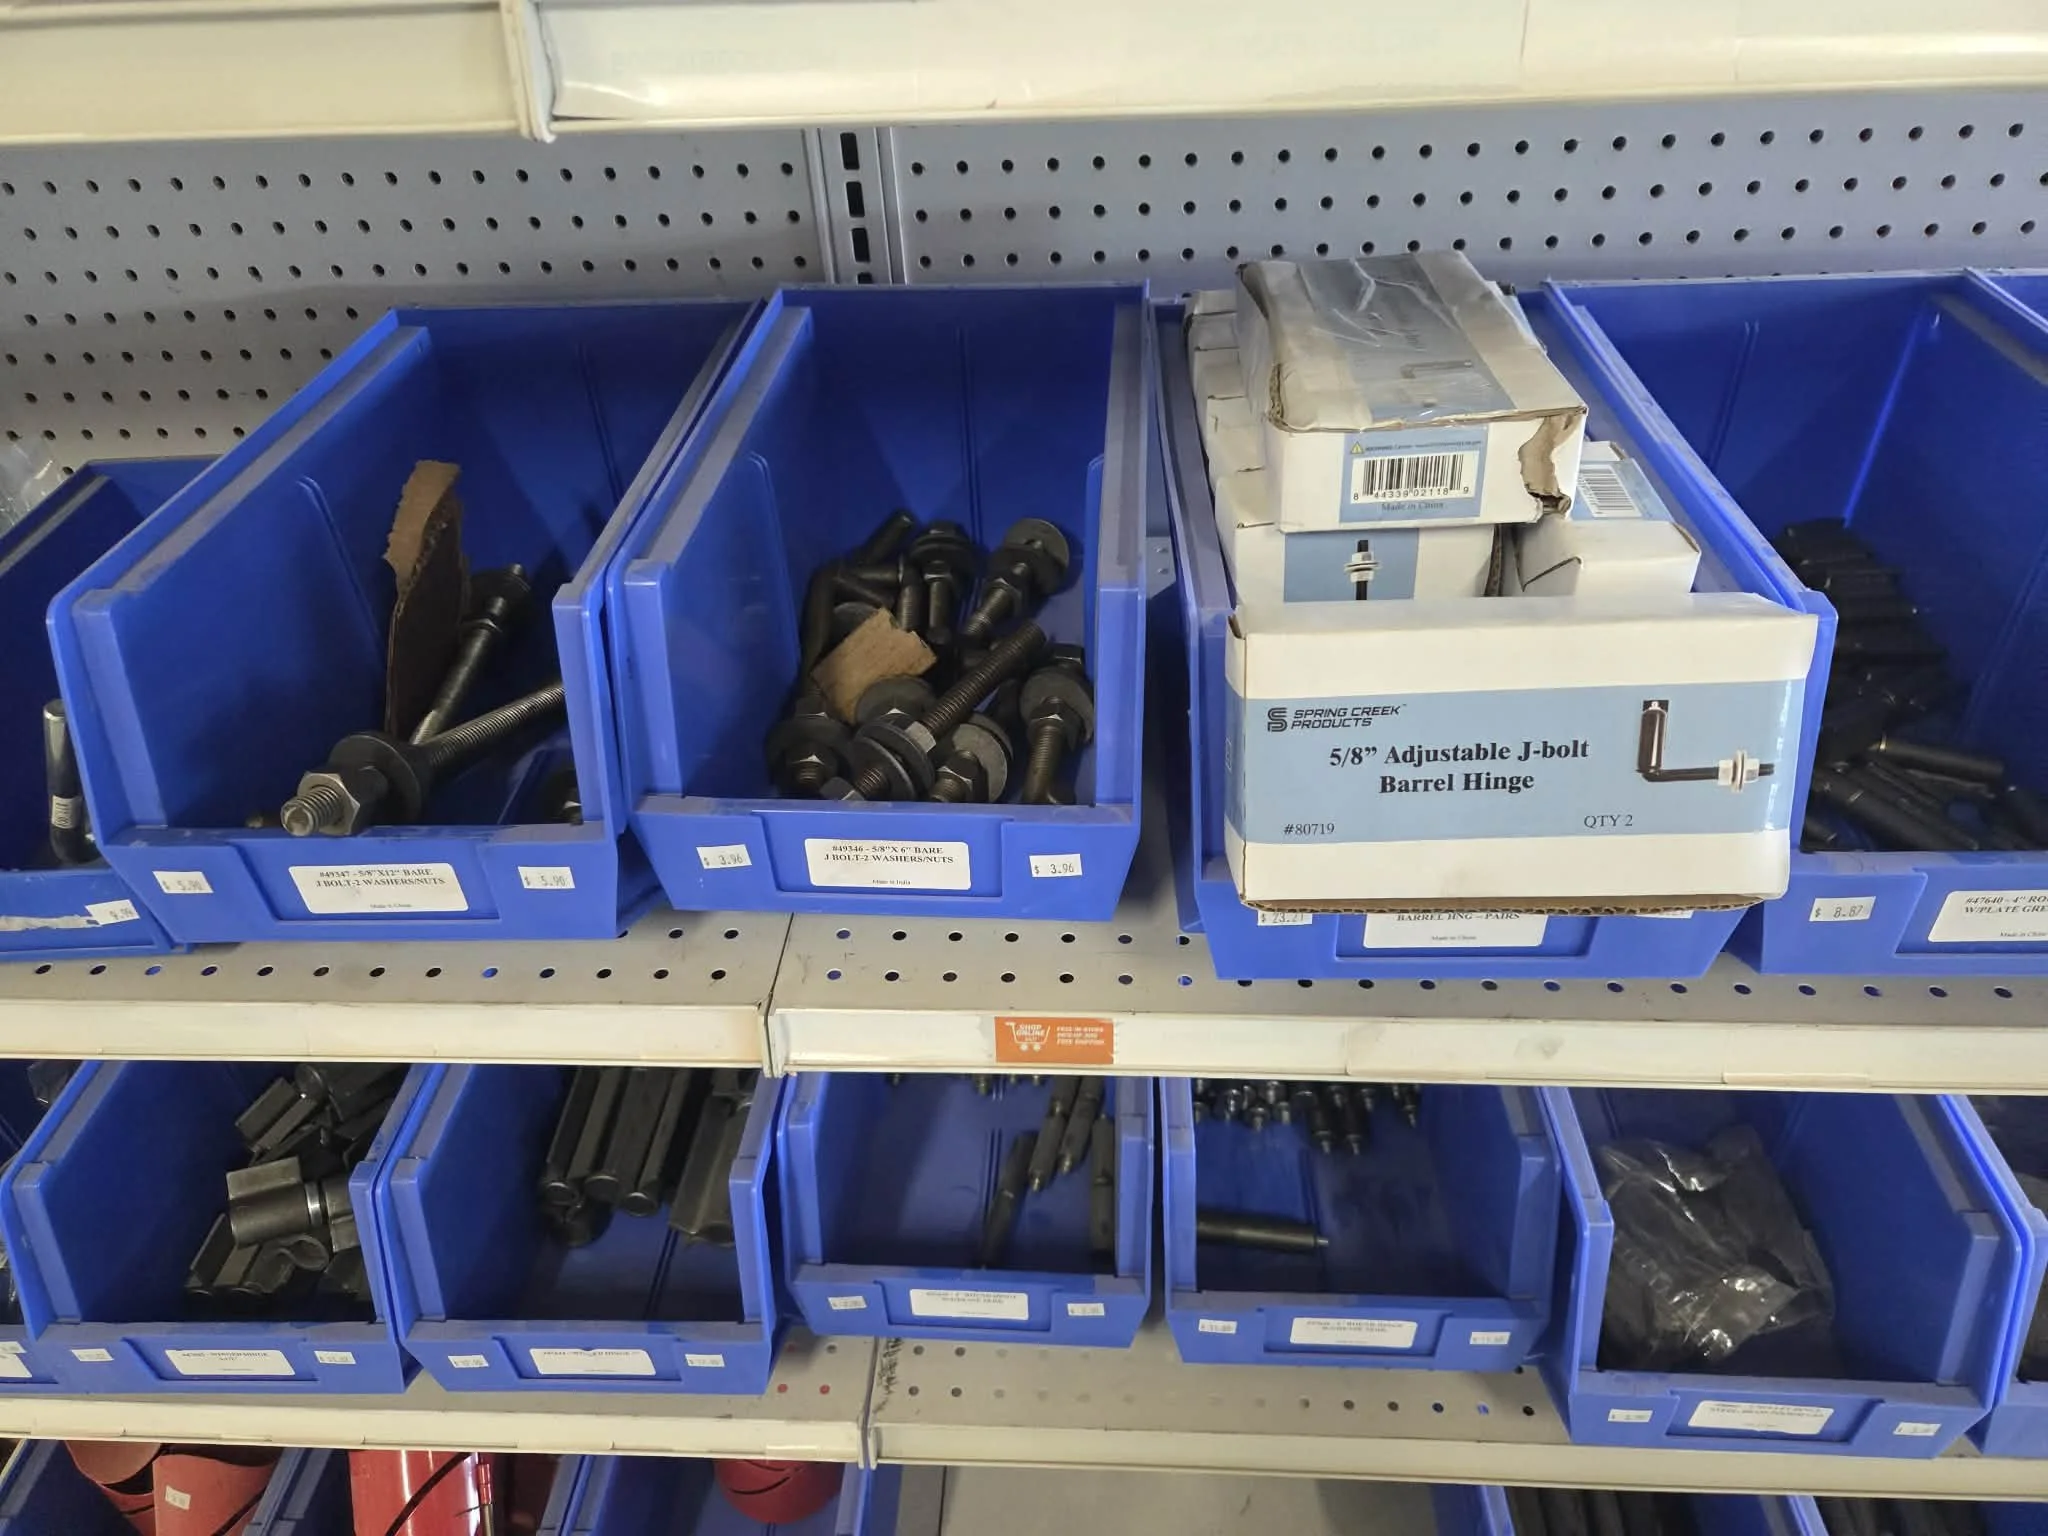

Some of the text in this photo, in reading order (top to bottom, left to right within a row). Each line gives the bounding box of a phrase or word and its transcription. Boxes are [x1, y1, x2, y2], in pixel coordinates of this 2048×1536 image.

[1353, 486, 1469, 500] 8 44339 02118 9
[1294, 705, 1401, 719] SPRING CREEK
[1291, 717, 1372, 730] PRODUCTS
[1383, 742, 1512, 768] Adjustable
[1517, 739, 1590, 763] J-bolt
[1379, 771, 1535, 794] Barrel Hinge
[1583, 814, 1633, 829] QTY 2
[1283, 822, 1335, 836] #80719
[914, 846, 944, 855] BARE
[718, 854, 743, 866] 3.96
[832, 854, 869, 862] BOLT-2
[872, 855, 954, 864] WASHERS/NUTS
[319, 870, 350, 878] #49347
[402, 868, 433, 876] BARE
[1034, 863, 1074, 875] $ 3.96
[323, 879, 361, 888] BOLT-2
[362, 877, 447, 887] WASHERS/NUTS
[1396, 913, 1444, 921] BARREL
[1484, 912, 1520, 920] PAIRS
[1815, 907, 1822, 918] $
[1016, 1029, 1046, 1037] ONLINE
